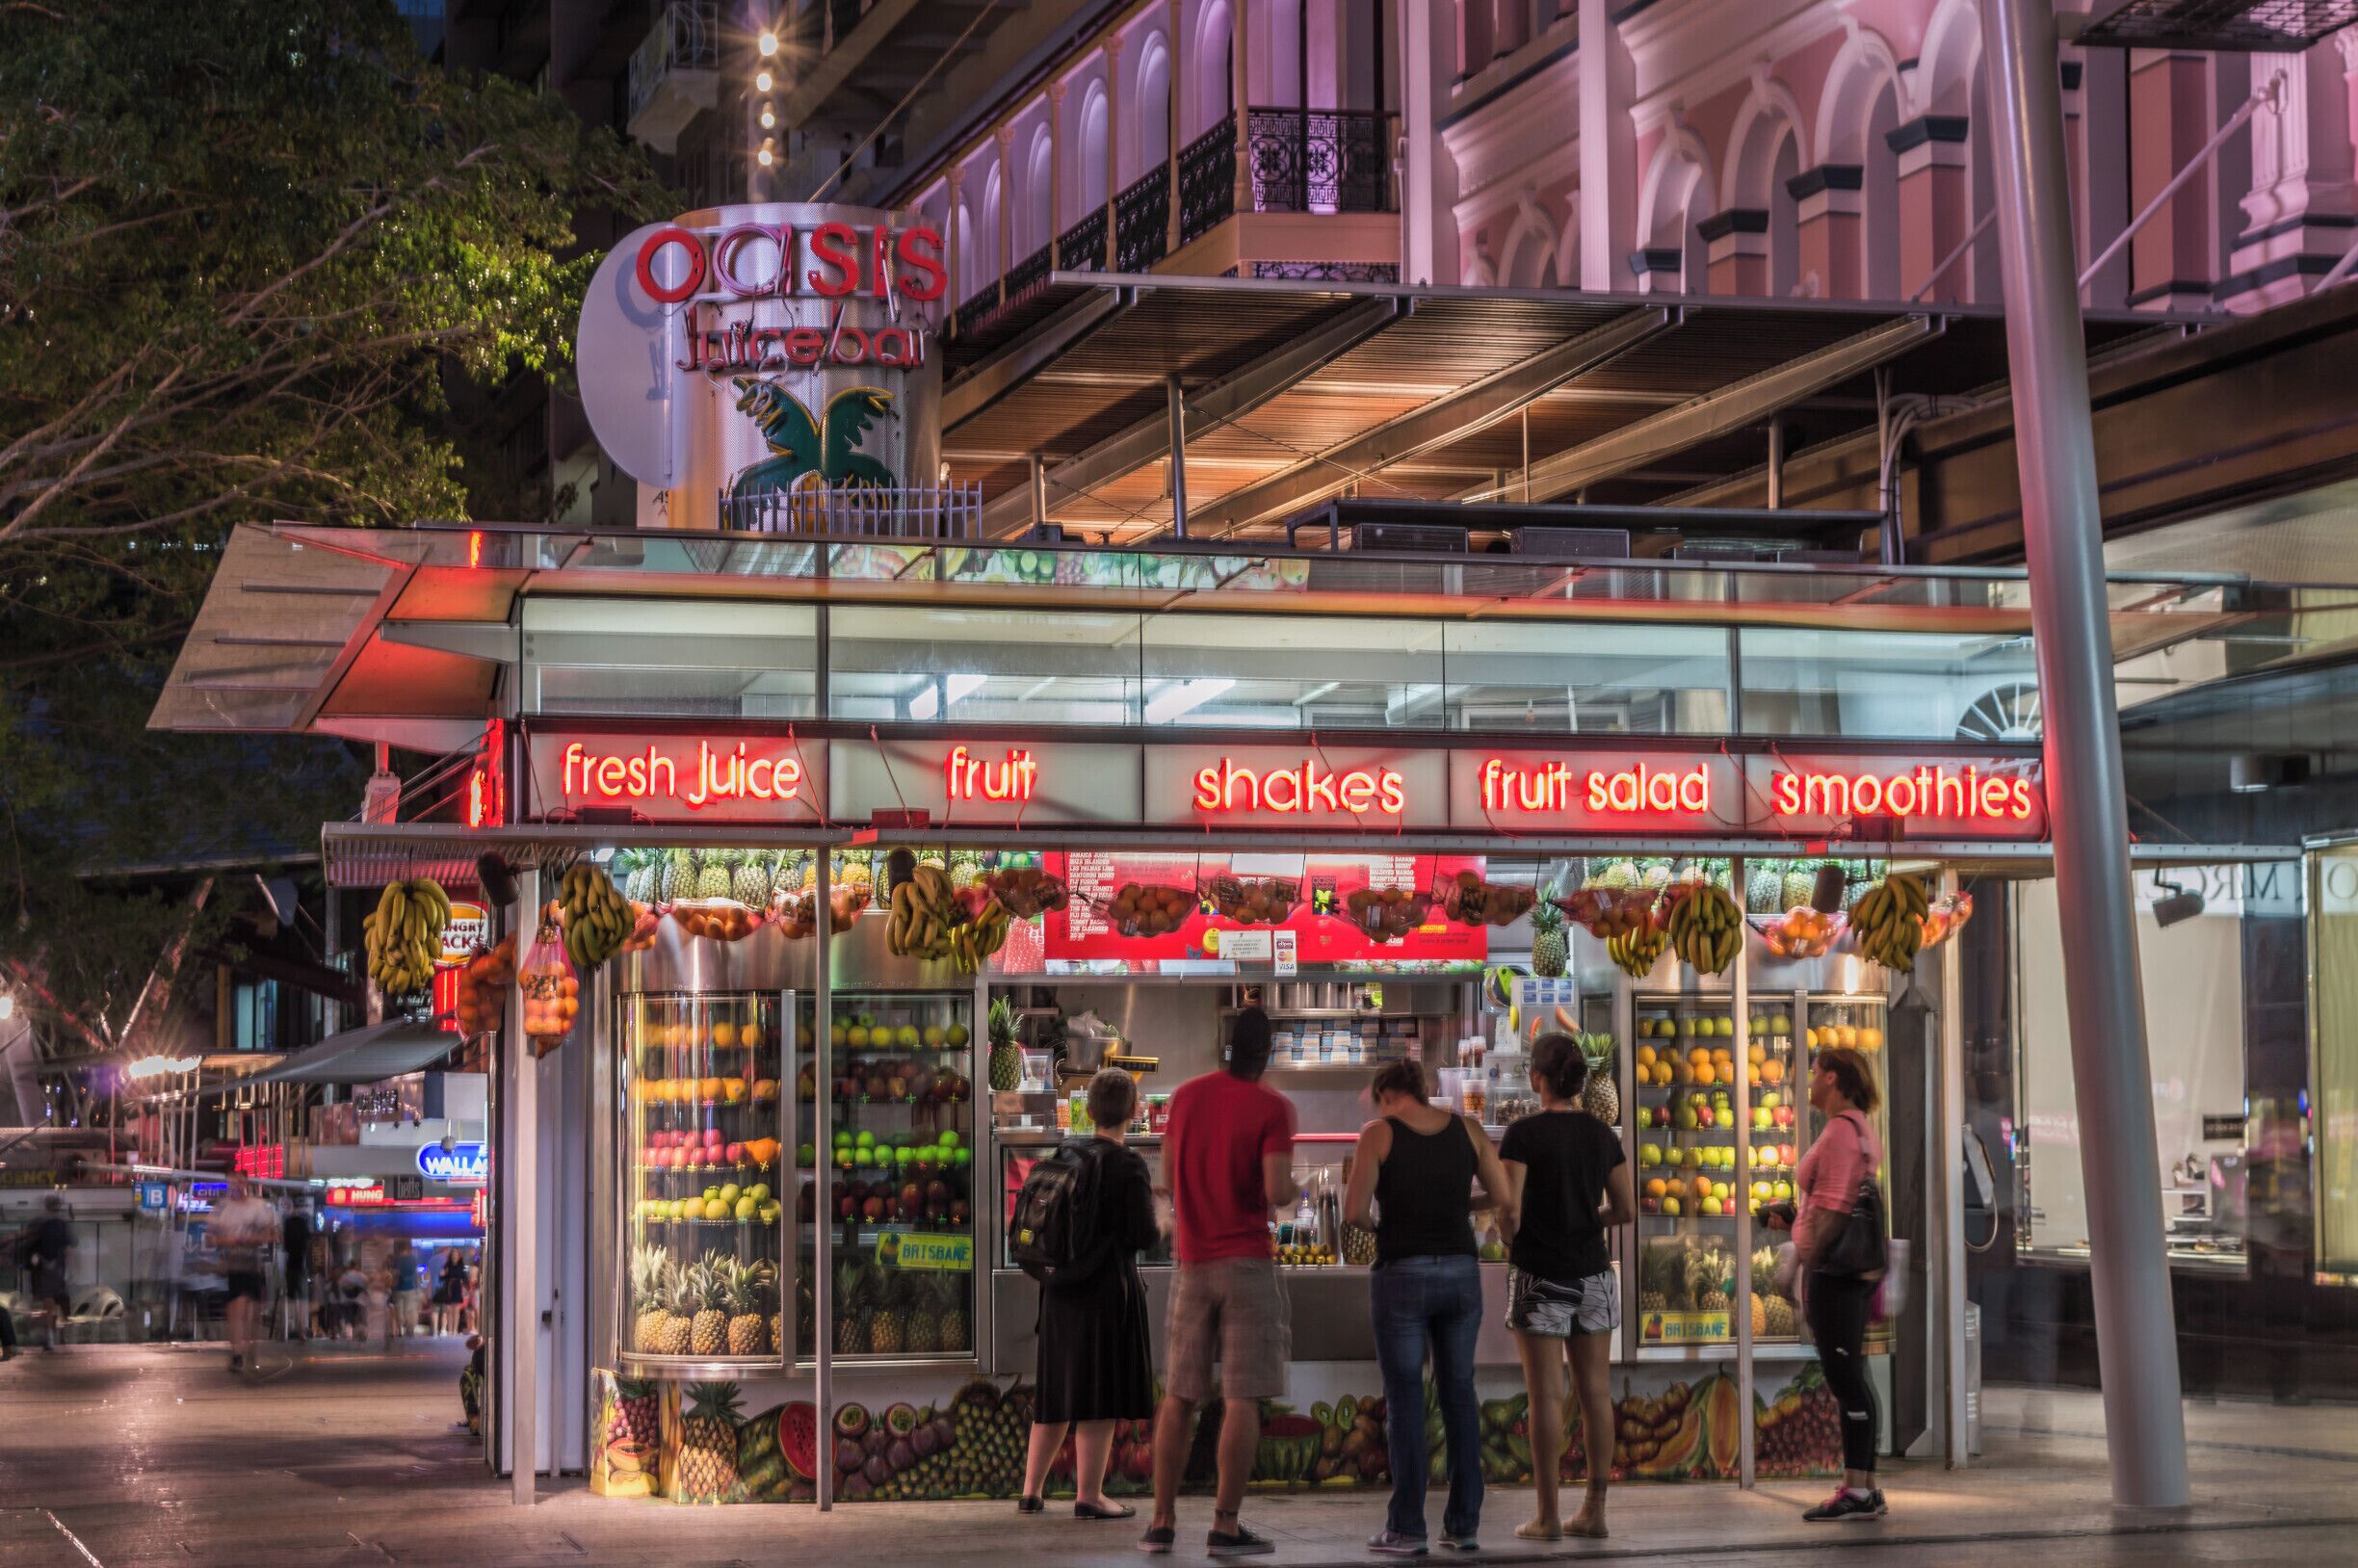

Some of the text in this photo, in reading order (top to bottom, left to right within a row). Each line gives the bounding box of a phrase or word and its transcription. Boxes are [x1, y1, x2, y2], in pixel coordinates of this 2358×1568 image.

[561, 742, 676, 798] fresh
[946, 745, 1037, 802] fruit
[1195, 757, 1405, 814] shakes
[1482, 758, 1709, 813] fruit salad
[1777, 764, 2032, 820] smoothies
[397, 1175, 420, 1199] betts
[903, 1242, 970, 1262] BRISBANE
